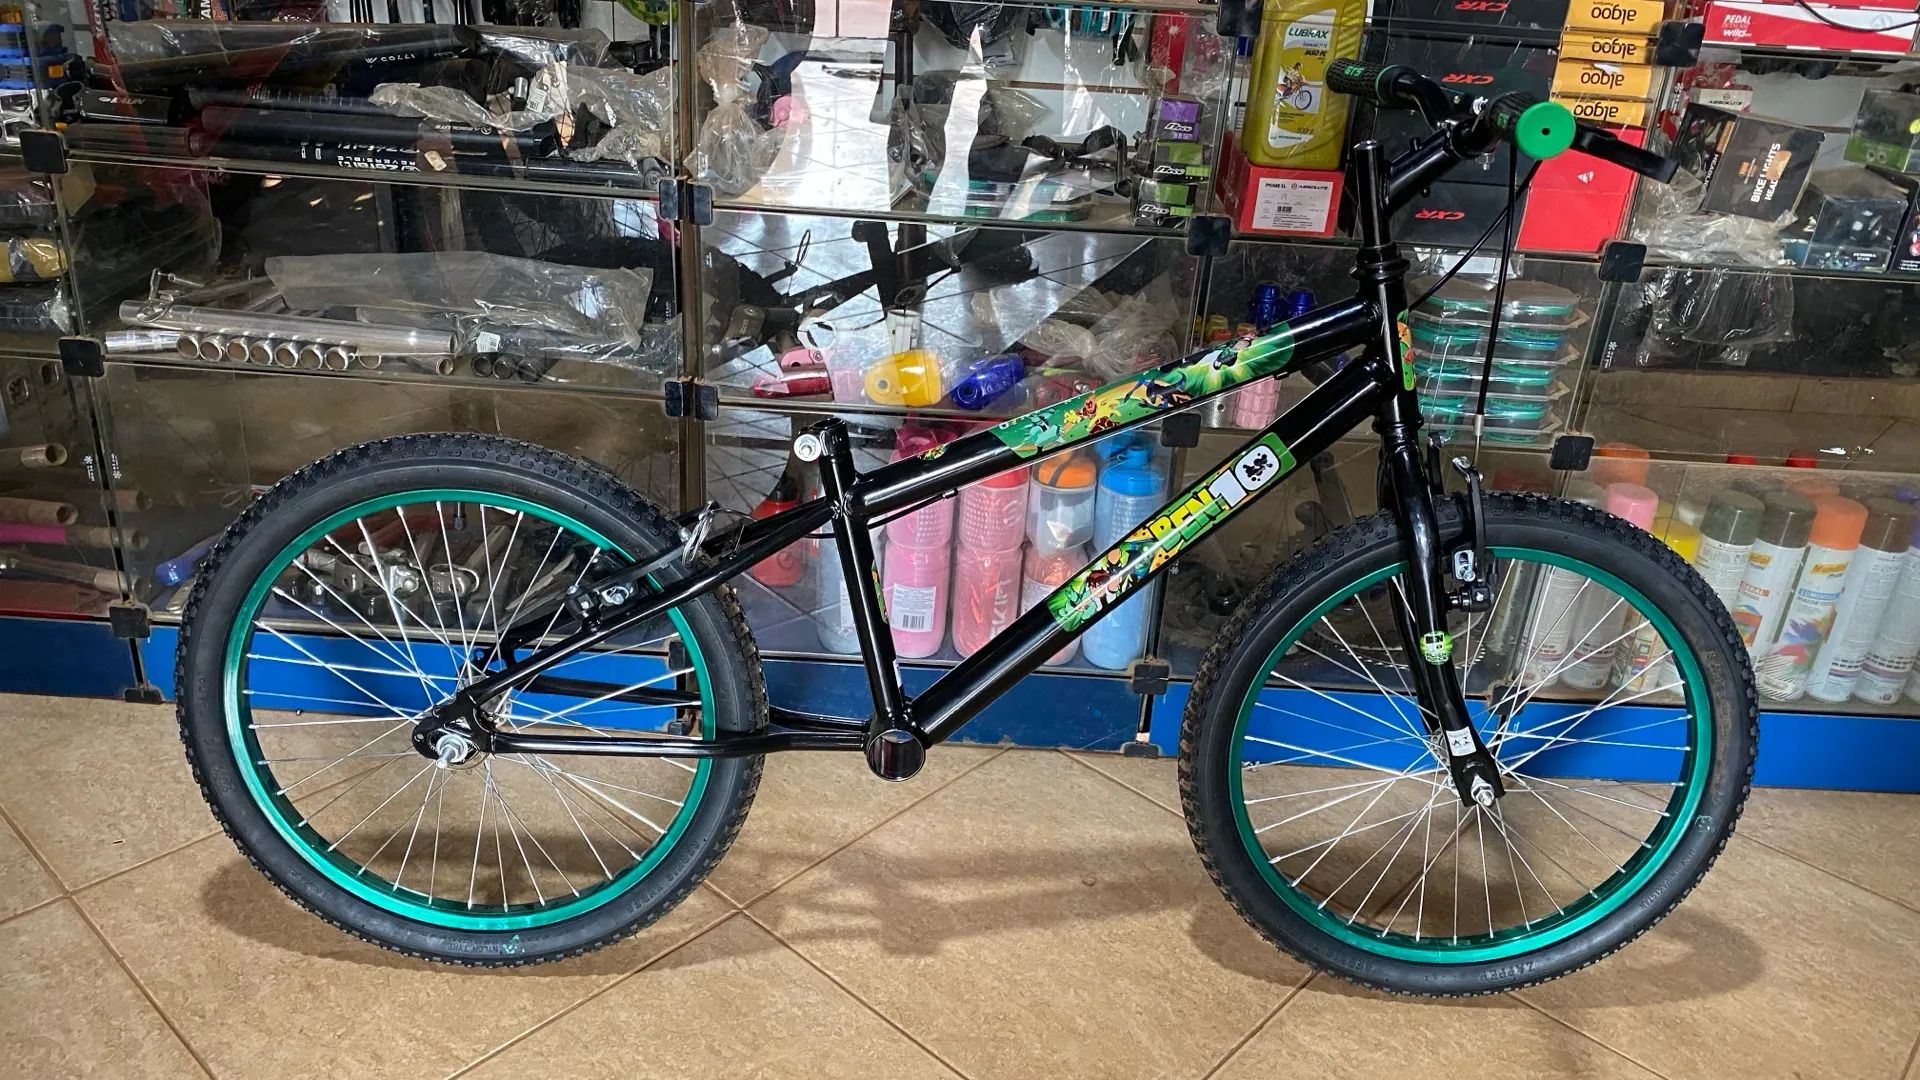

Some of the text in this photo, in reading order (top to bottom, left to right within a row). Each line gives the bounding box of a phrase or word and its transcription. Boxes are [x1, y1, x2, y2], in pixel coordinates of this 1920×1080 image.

[1454, 0, 1508, 11] CXR
[1591, 4, 1637, 25] algoo
[1724, 14, 1752, 25] PEDAL
[1591, 38, 1637, 59] algoo
[1441, 73, 1494, 85] CXR
[1580, 71, 1625, 90] algoo
[1573, 102, 1619, 121] algoo
[336, 155, 416, 166] REVERSIBLE
[1750, 176, 1767, 203] BIKE
[1414, 208, 1465, 220] CXR
[1149, 445, 1280, 551] BEN 10
